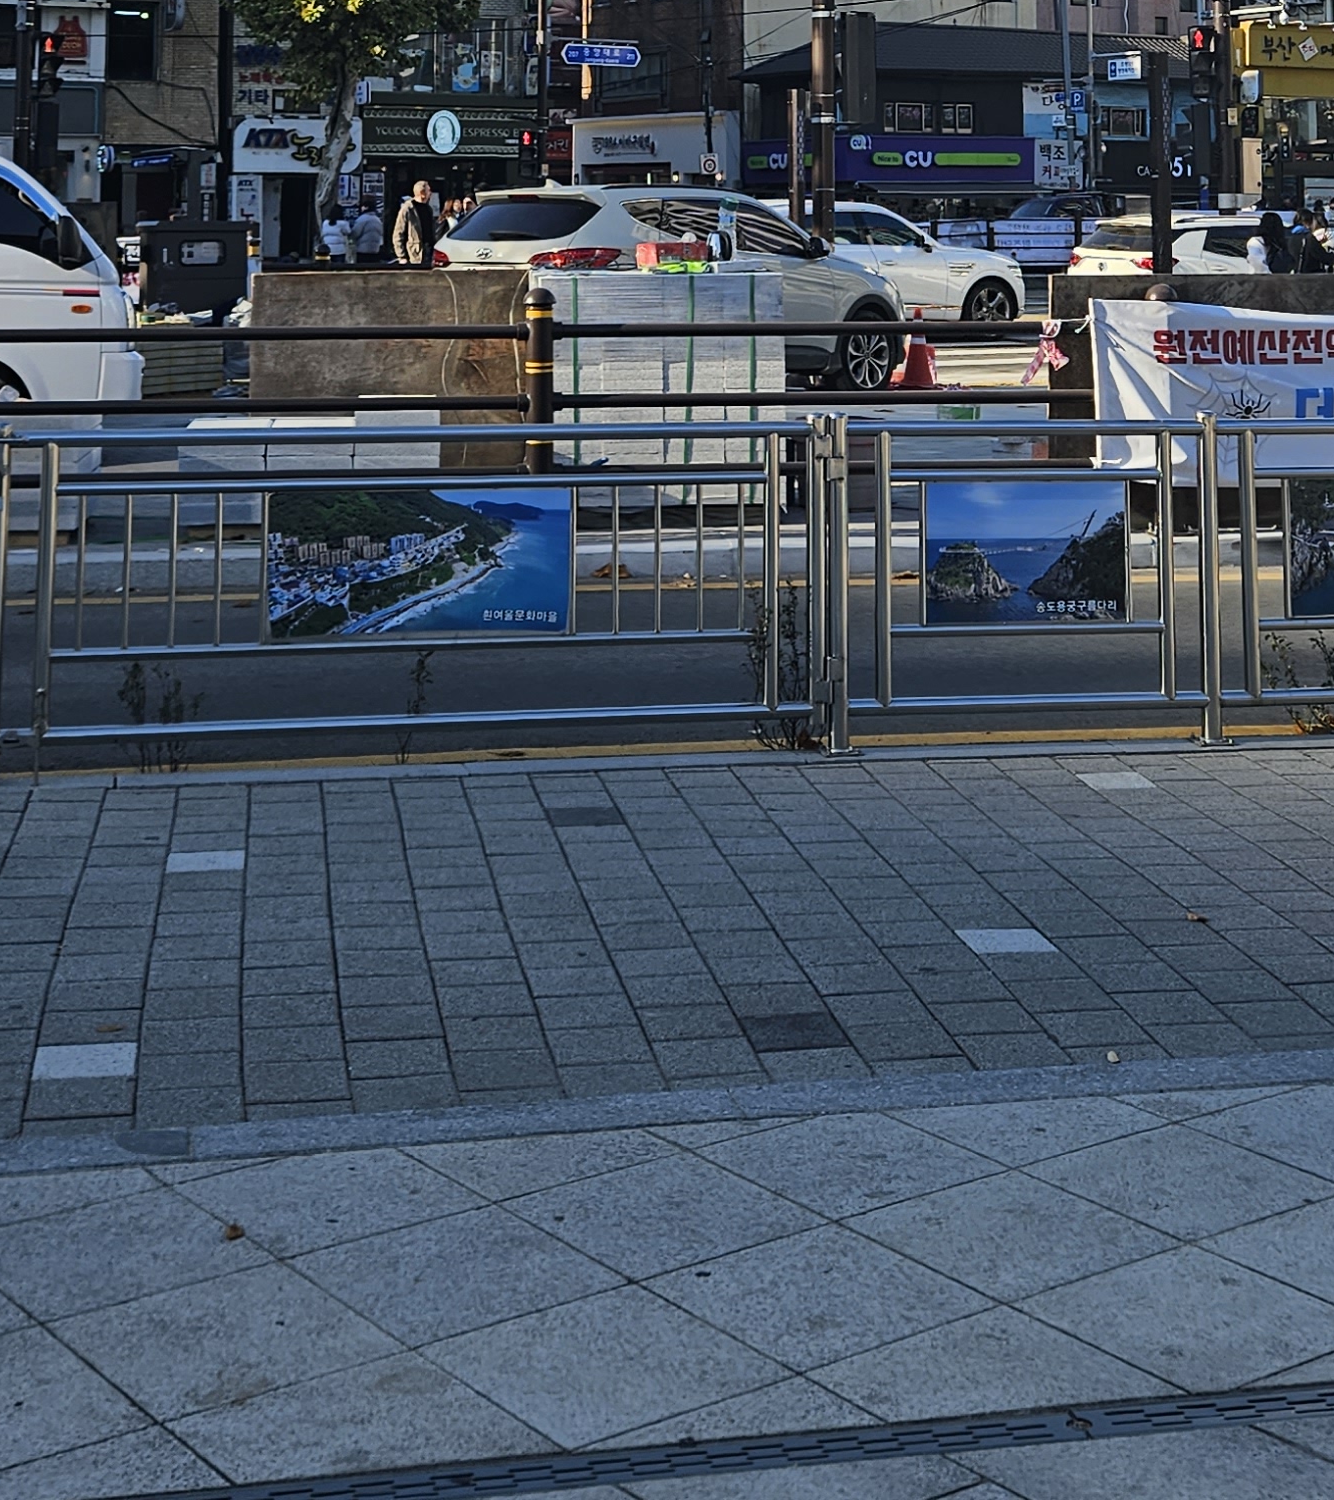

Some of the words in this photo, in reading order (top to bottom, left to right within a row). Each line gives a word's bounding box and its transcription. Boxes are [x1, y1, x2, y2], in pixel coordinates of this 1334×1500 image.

[1261, 35, 1297, 62] 부산
[237, 89, 269, 105] 기타
[1073, 93, 1081, 107] P
[242, 128, 291, 149] KTX
[375, 125, 422, 136] YOUDONG
[463, 125, 512, 137] ESPRESSO
[877, 155, 891, 165] Nice
[891, 156, 900, 165] to
[904, 150, 933, 168] CU
[1039, 143, 1066, 161] 백조
[769, 153, 789, 170] CU
[1035, 598, 1117, 614] 송도용궁구름다리
[482, 607, 558, 624] 흰여울문화마을
